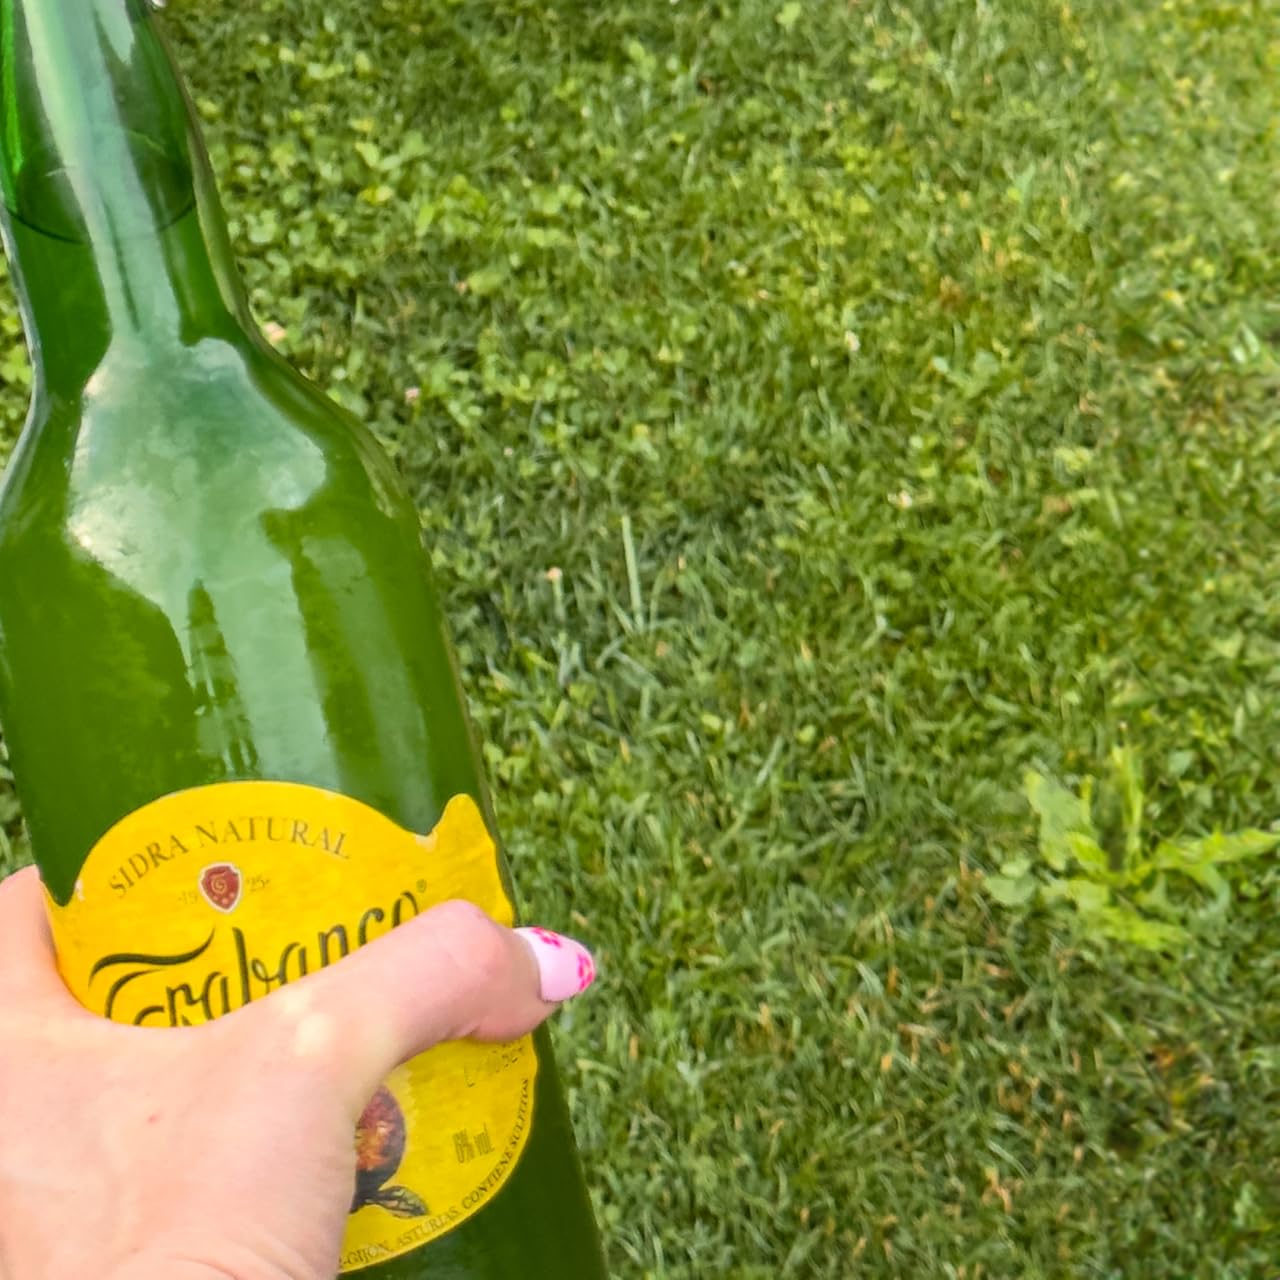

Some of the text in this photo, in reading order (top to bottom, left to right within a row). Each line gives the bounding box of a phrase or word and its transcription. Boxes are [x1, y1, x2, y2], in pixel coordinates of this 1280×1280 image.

[108, 816, 350, 898] SIDRA NATURAL
[461, 1150, 514, 1210] CONTIENE
